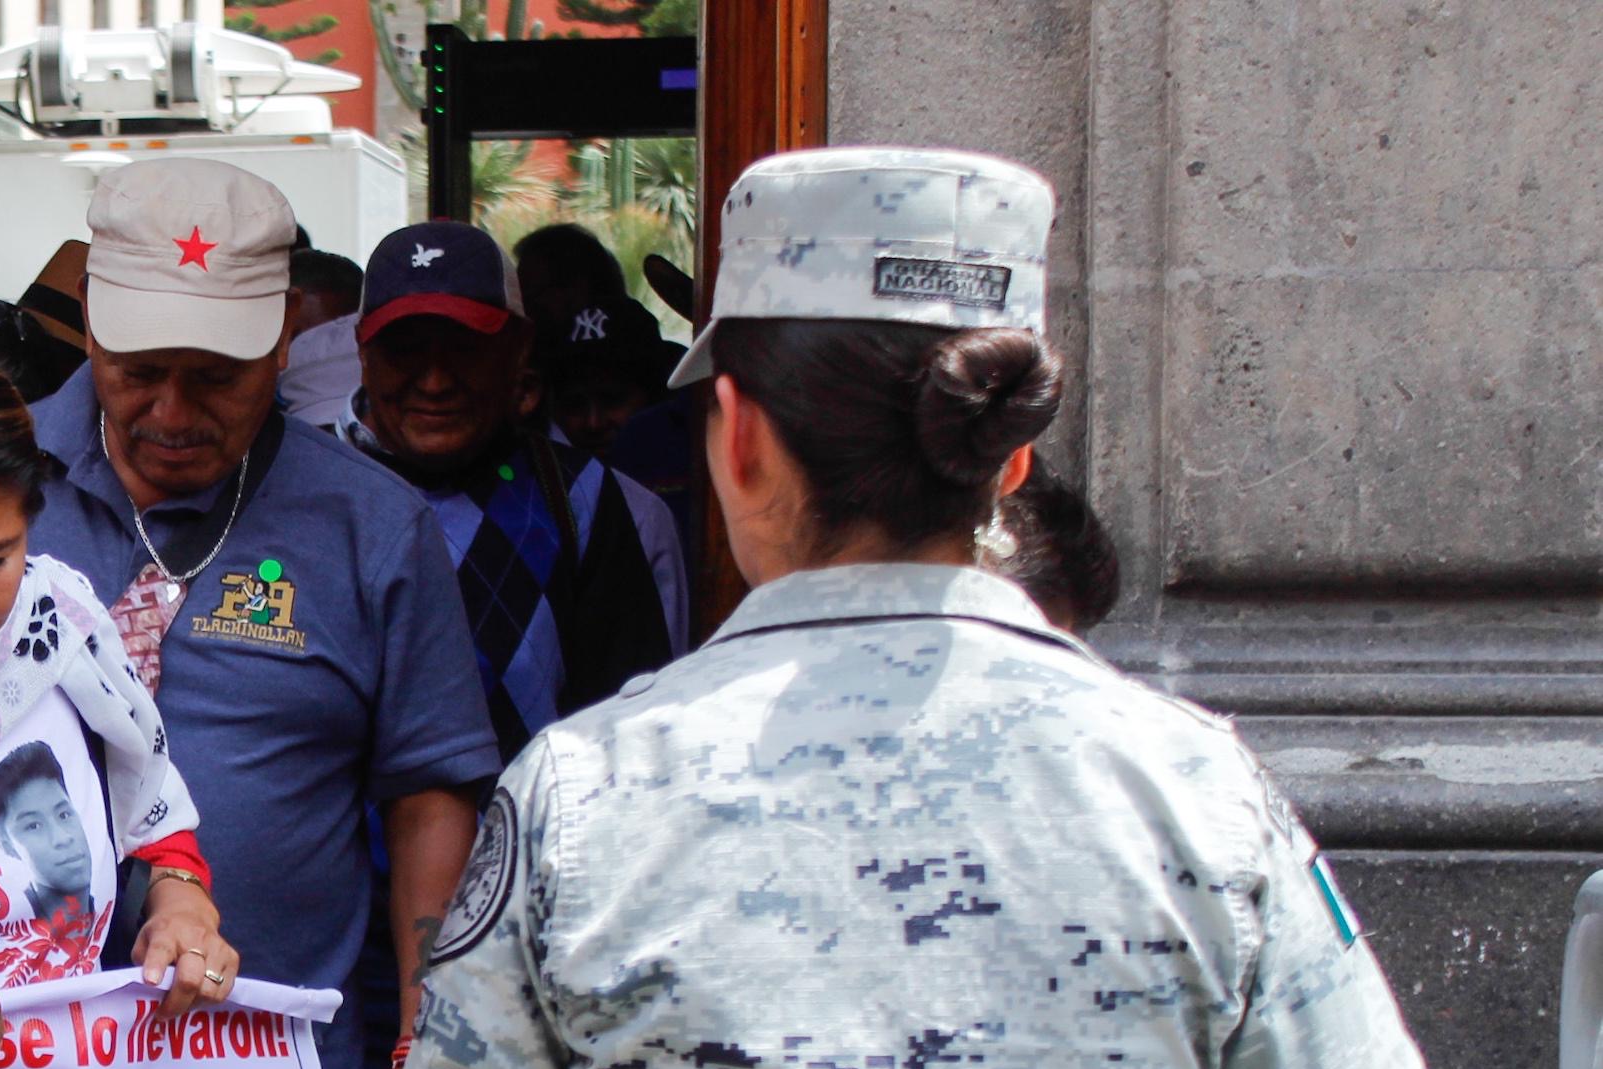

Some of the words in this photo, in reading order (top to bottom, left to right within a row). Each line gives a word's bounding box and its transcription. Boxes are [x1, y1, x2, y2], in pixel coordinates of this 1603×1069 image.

[885, 273, 999, 298] NACIONAL
[192, 617, 306, 647] TLACHINOLLAN
[68, 1001, 119, 1066] lo
